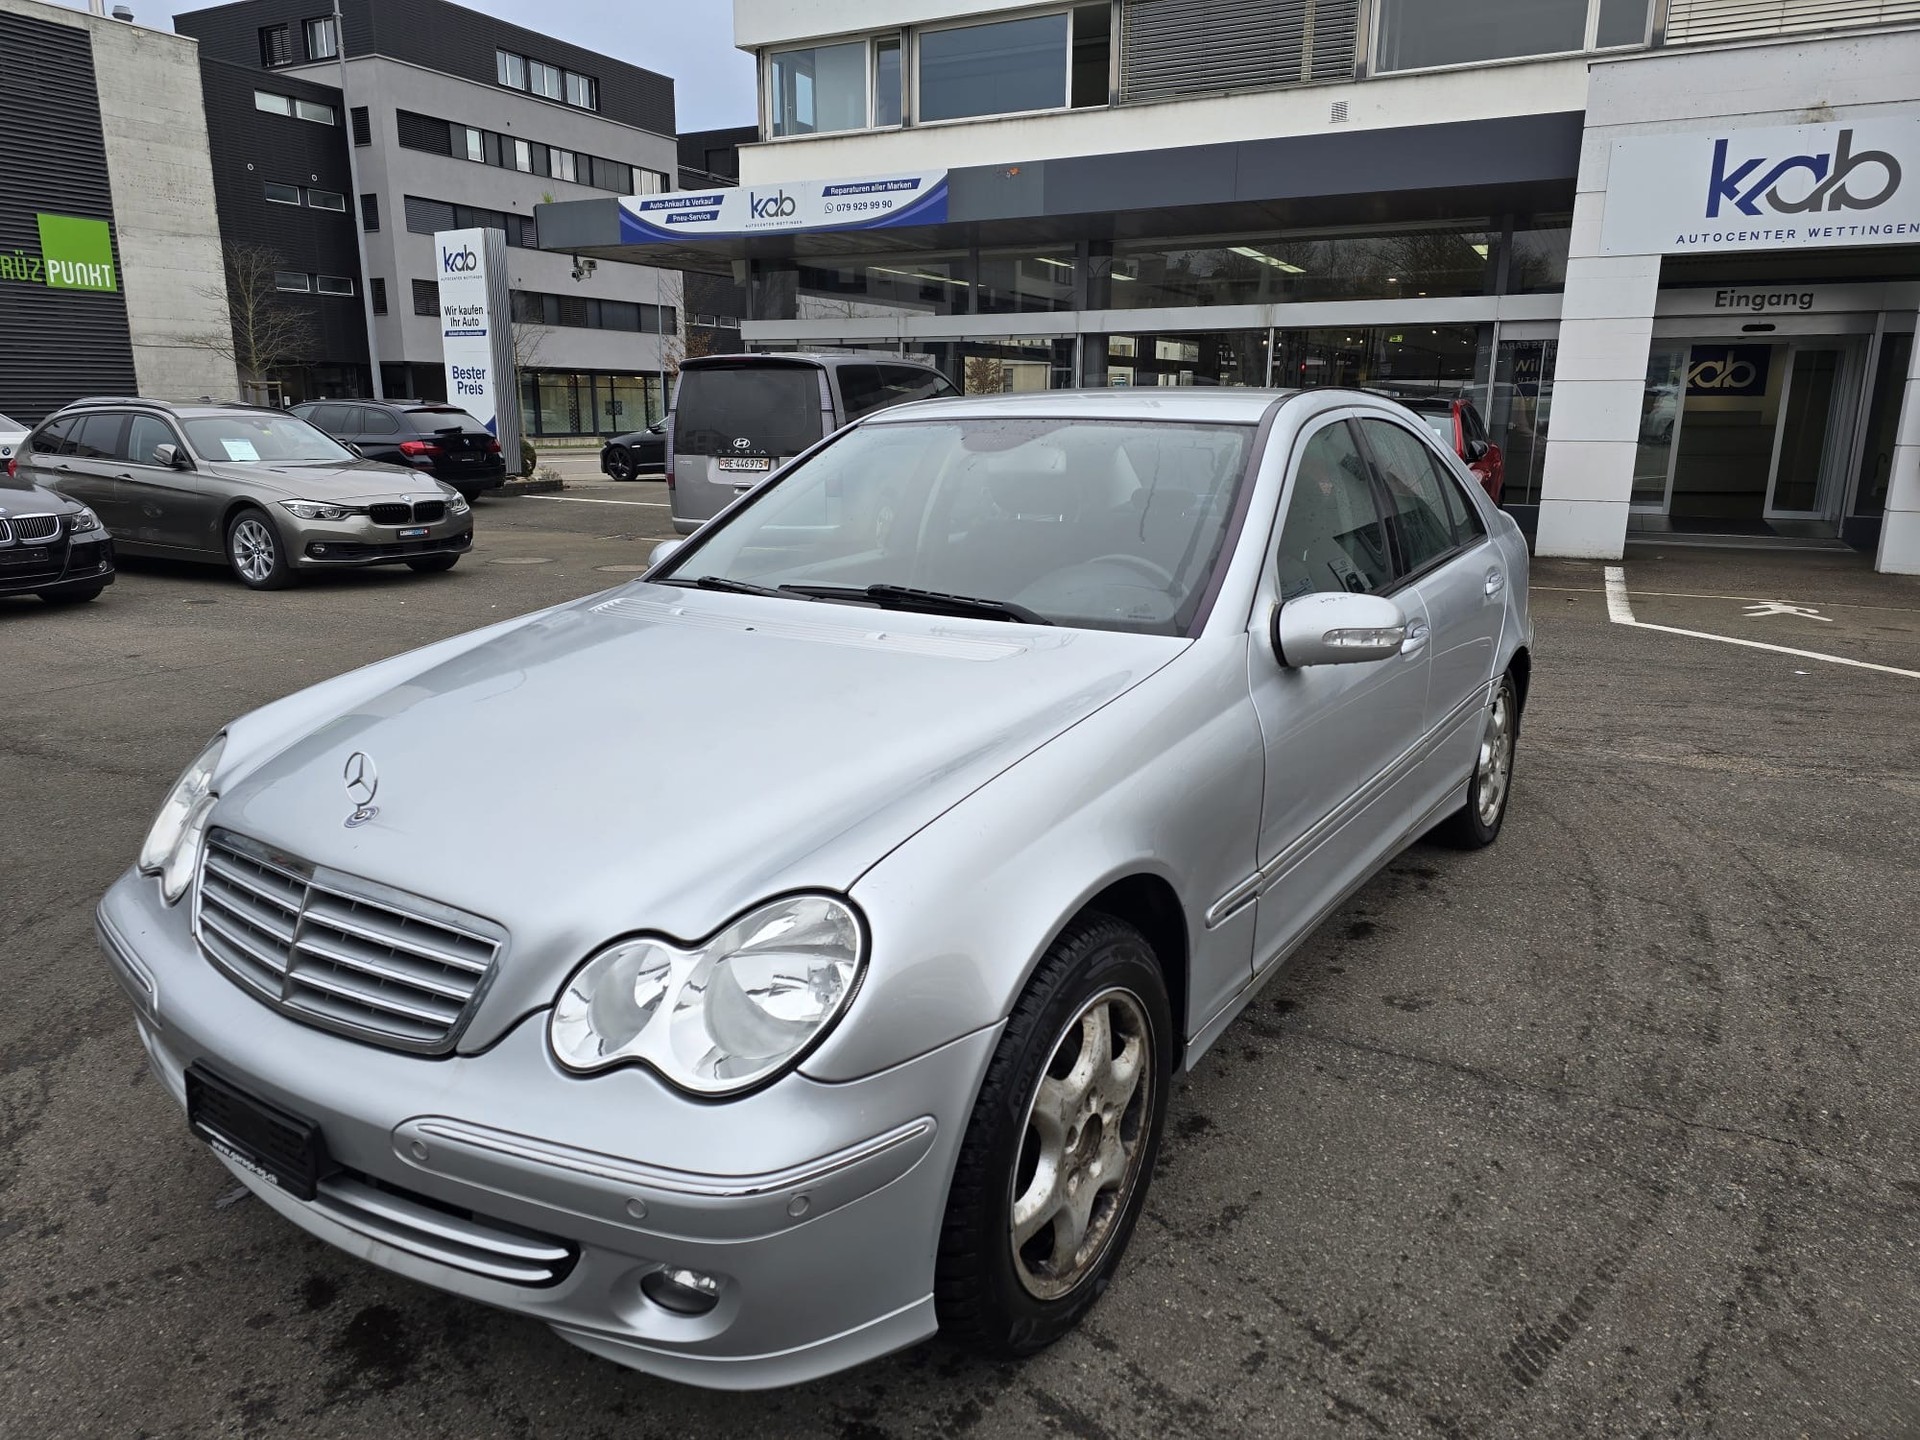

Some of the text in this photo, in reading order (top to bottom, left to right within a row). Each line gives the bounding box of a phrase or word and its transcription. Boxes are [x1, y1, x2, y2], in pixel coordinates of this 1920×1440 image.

[1706, 129, 1902, 218] kab
[830, 181, 912, 196] Reparaturen aller Marken
[650, 196, 714, 209] Auto-Ankauf & Verkauf
[750, 189, 796, 219] kab
[836, 200, 893, 212] 079 929 99 90
[672, 212, 711, 222] Pneu-Service
[1676, 222, 1920, 245] AUTOCENTER WETTINGEN
[442, 244, 477, 273] kab
[1714, 289, 1815, 311] Eingang
[444, 304, 484, 316] Wir kaufen
[450, 316, 480, 327] Ihr Auto
[452, 366, 486, 380] Bester
[457, 380, 484, 395] Preis
